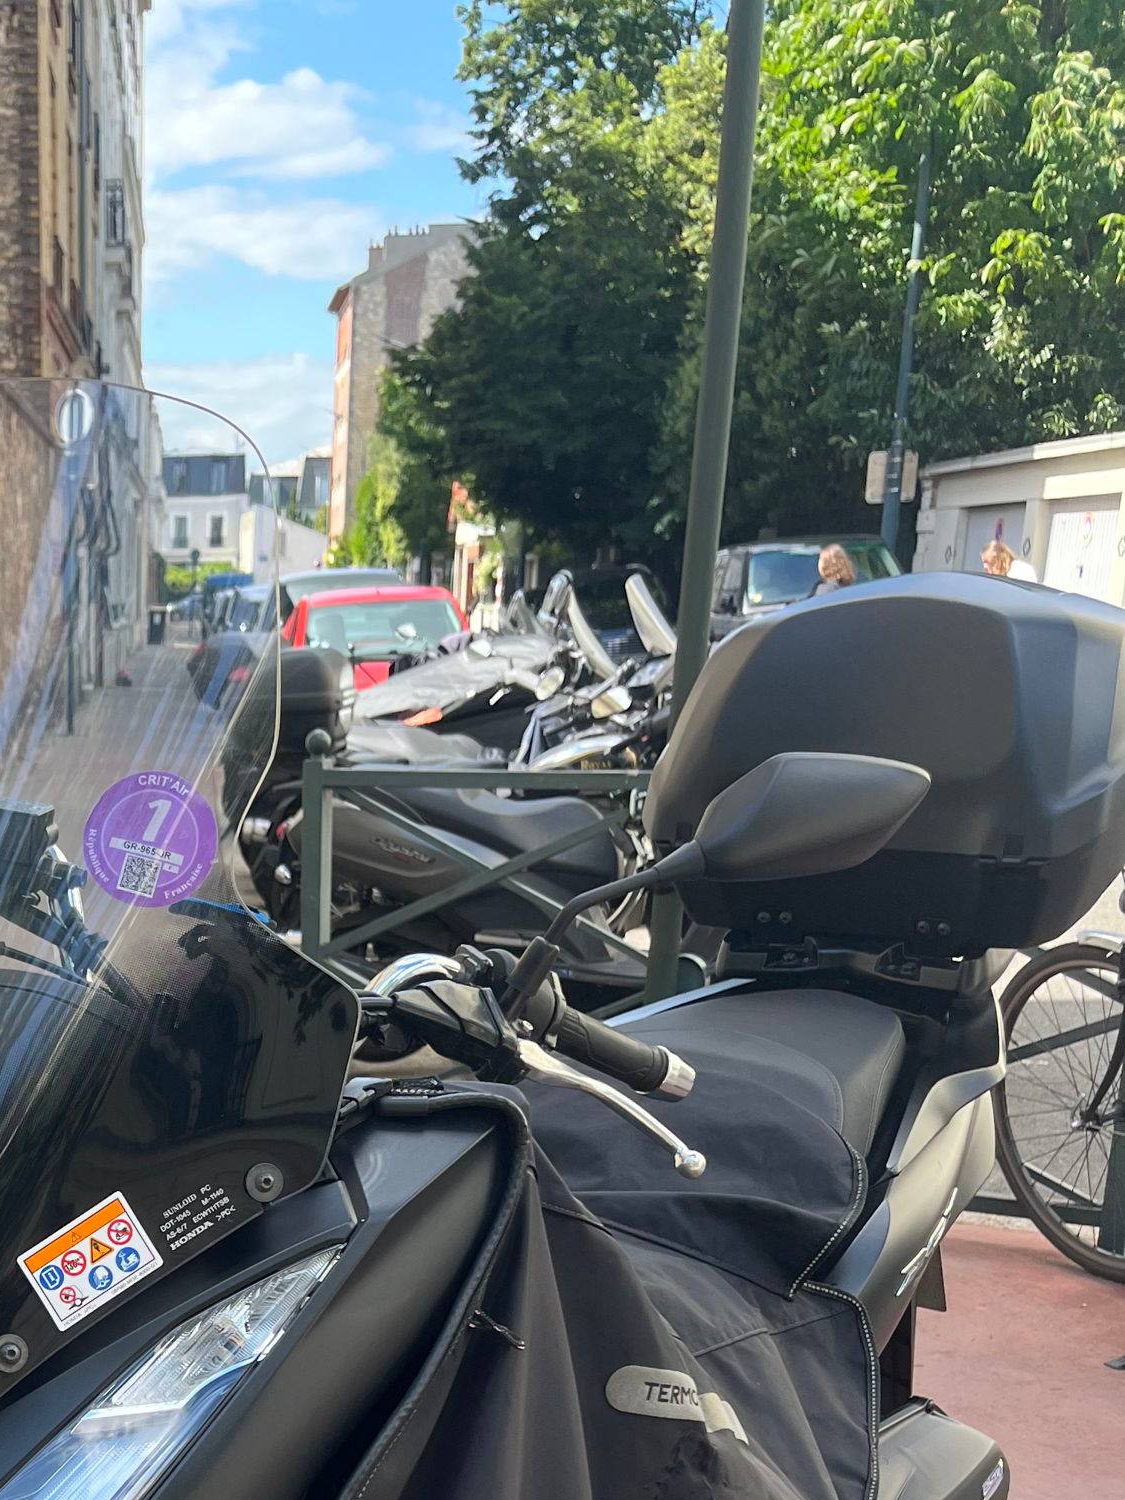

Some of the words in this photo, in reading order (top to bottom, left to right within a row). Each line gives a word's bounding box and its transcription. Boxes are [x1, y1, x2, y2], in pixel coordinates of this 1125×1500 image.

[142, 798, 172, 842] 1
[200, 1184, 211, 1194] PC
[169, 1220, 214, 1251] HONDA
